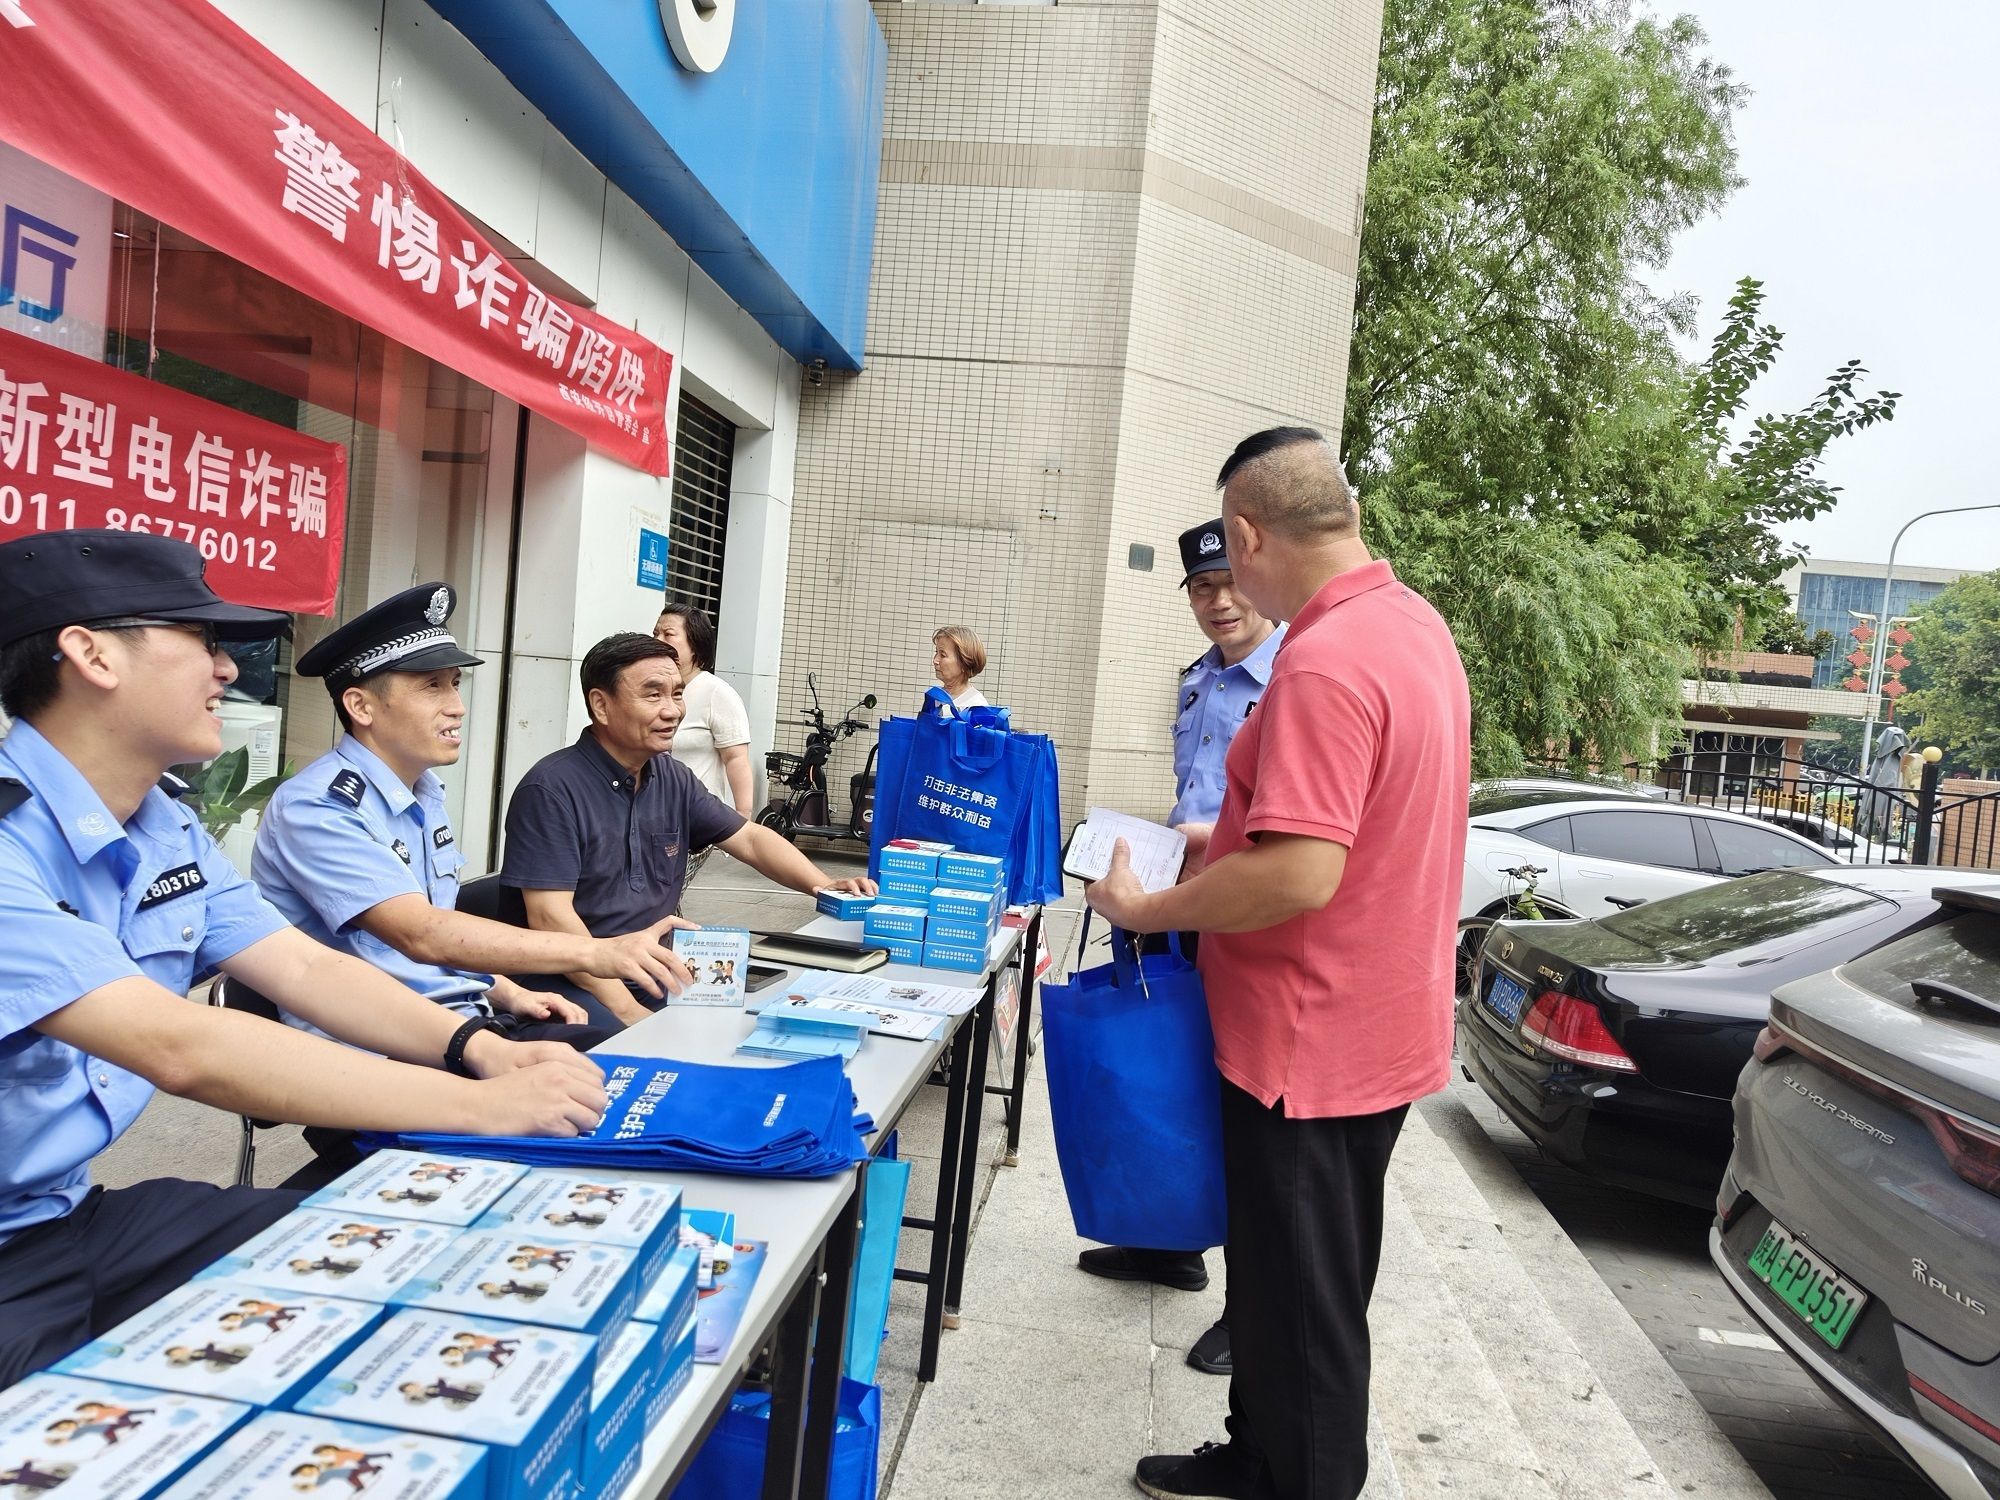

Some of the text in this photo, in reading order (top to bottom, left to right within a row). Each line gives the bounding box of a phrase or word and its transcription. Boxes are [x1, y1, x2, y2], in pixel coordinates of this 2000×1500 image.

[0, 204, 80, 324] 厅
[273, 107, 647, 414] 警惕诈骗陷阱
[0, 367, 328, 539] 新型电信诈骗
[916, 794, 993, 830] 维护群众利益
[923, 775, 999, 810] 打击非法集资
[1808, 1091, 1837, 1114] YOUR
[1836, 1109, 1895, 1145] DREAMS
[1929, 1276, 1987, 1315] PLUS
